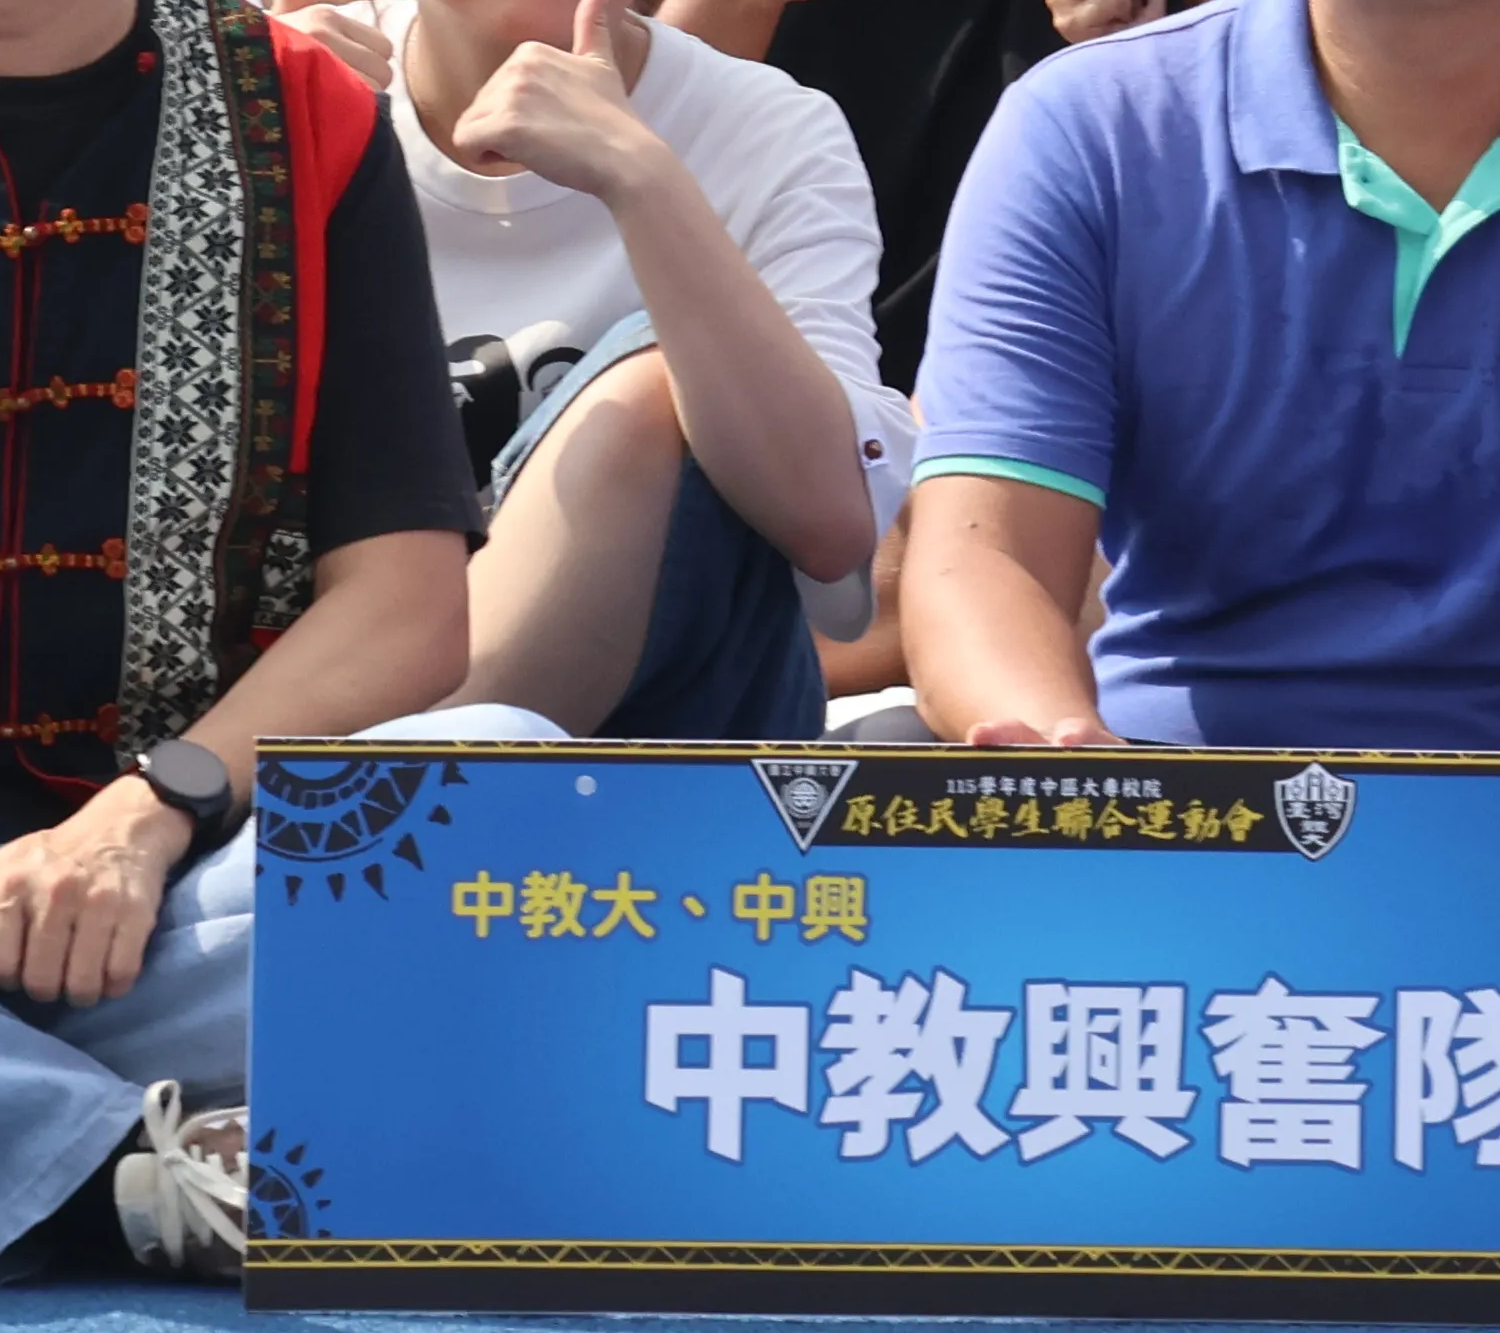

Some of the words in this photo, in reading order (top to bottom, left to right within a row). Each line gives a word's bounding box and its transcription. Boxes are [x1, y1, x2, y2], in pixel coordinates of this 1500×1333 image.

[840, 794, 1266, 842] 原住民學生聯合運動會
[453, 872, 868, 941] 中教大、中興
